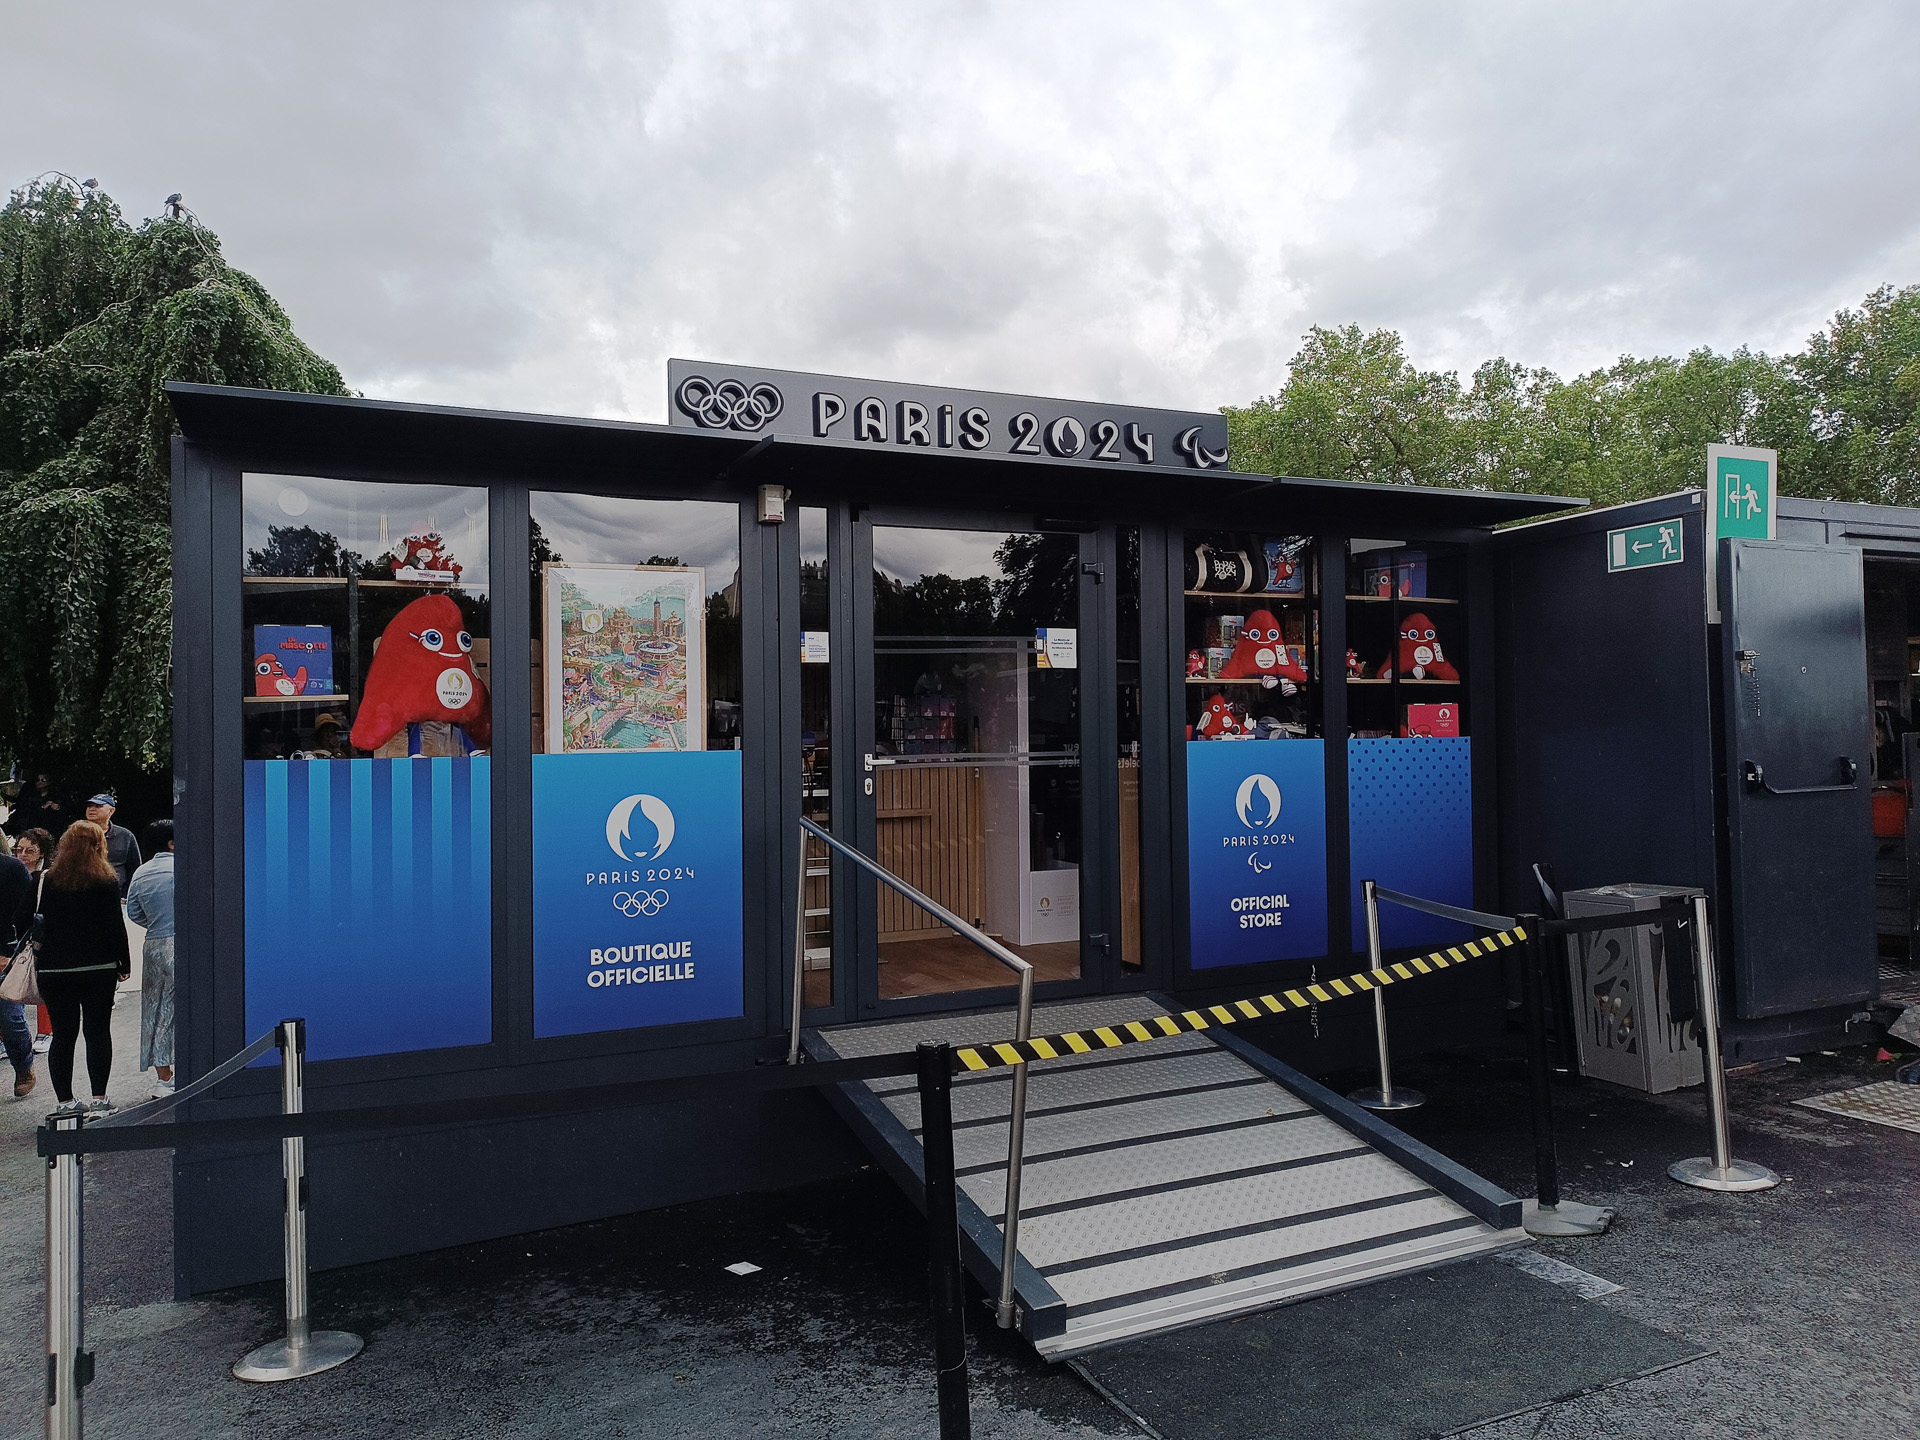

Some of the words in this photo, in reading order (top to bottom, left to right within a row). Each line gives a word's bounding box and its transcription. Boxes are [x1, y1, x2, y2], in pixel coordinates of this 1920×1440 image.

[1010, 411, 1154, 464] 2024
[1263, 833, 1295, 845] 2024
[647, 867, 695, 882] 2024
[1230, 894, 1290, 912] OFFICIAL
[1239, 912, 1282, 929] STORE
[590, 941, 692, 966] BOUTIQUE
[587, 962, 695, 988] OFFICIELLE
